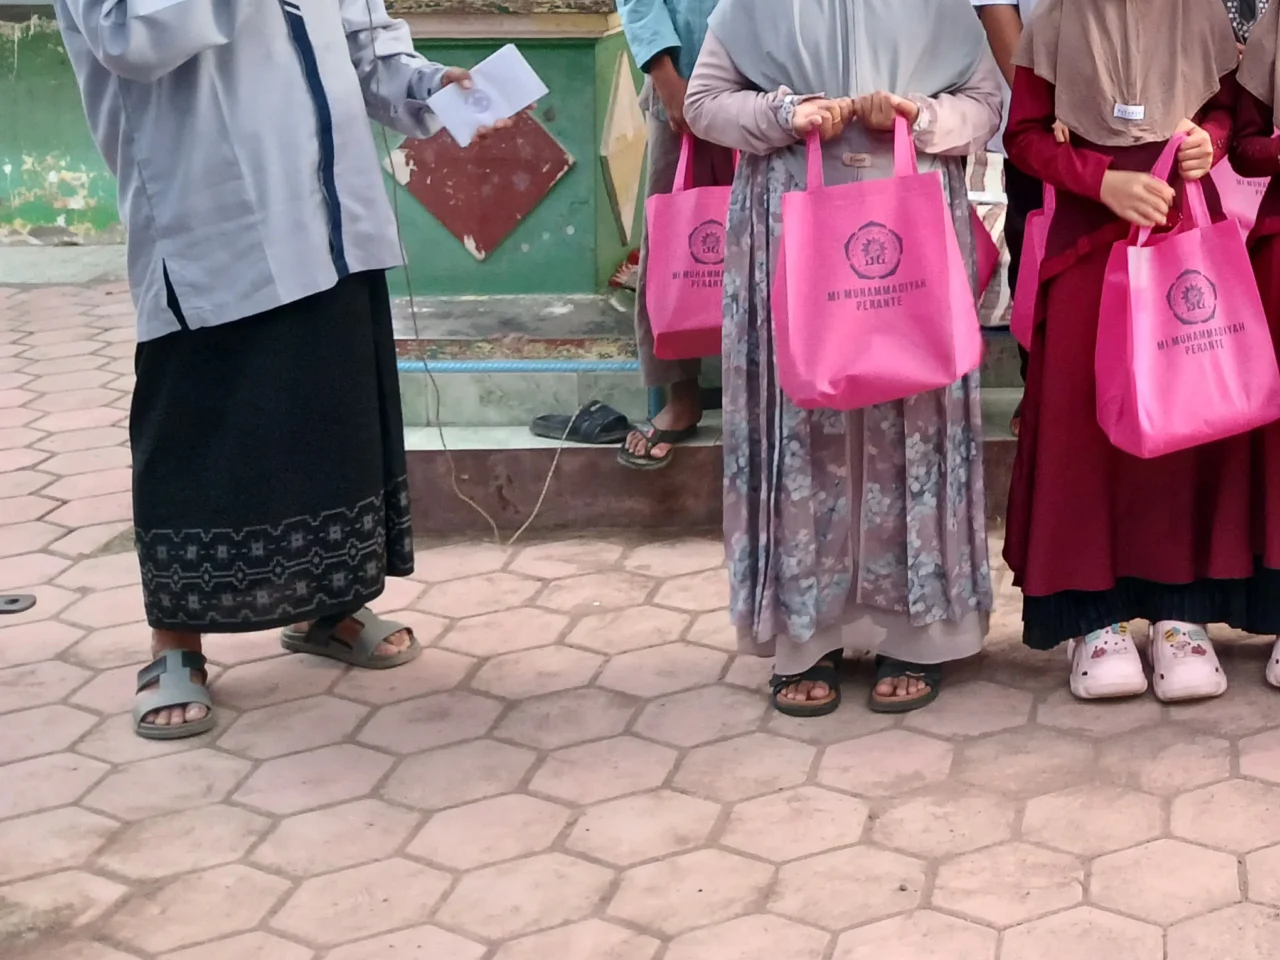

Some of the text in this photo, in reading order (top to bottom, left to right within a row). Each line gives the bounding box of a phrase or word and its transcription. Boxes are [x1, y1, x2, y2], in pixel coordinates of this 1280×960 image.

[827, 279, 927, 301] MI MUHAMMADIYAH
[856, 295, 903, 311] PERANTE
[1157, 322, 1246, 350] MI MUHAMMADIYAH
[1184, 339, 1224, 355] PERANTE
